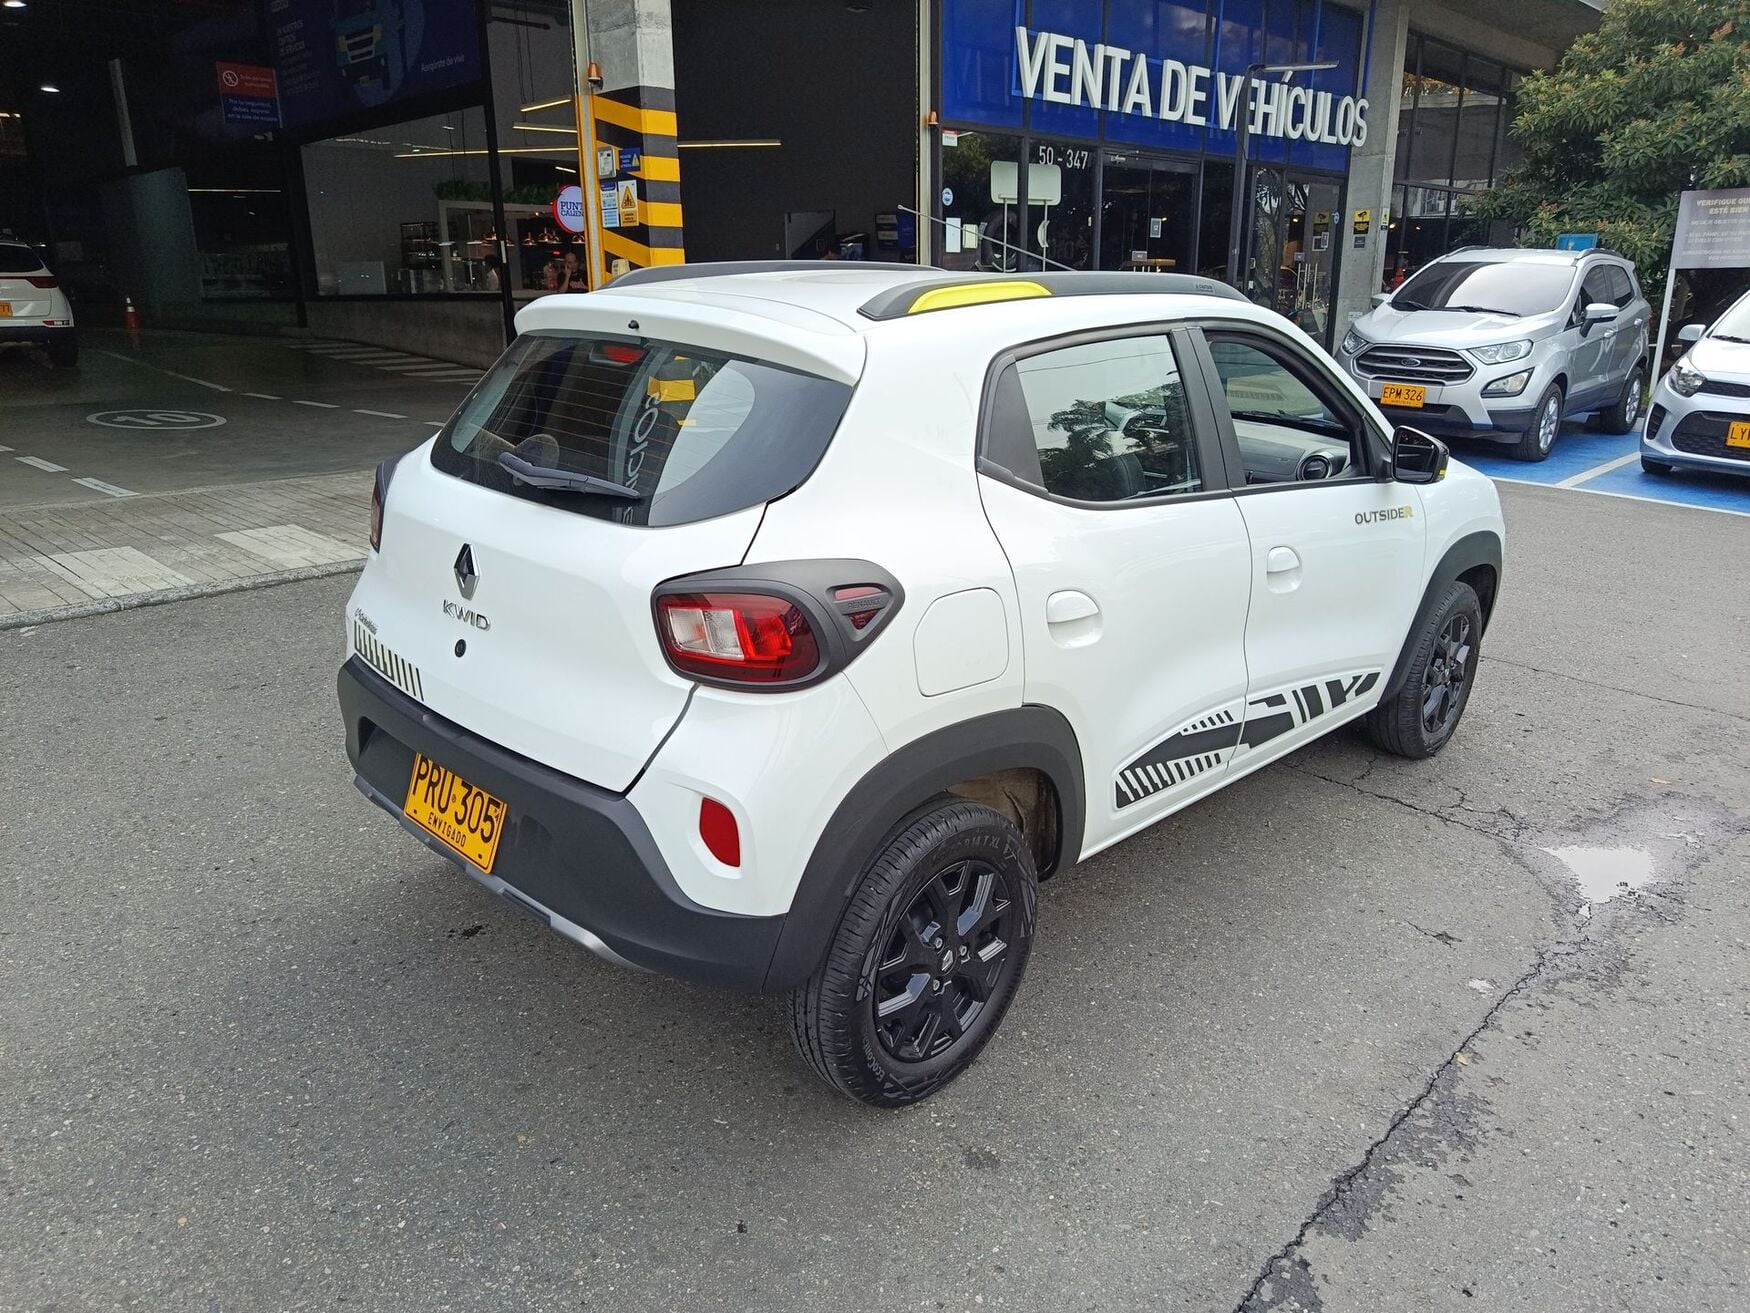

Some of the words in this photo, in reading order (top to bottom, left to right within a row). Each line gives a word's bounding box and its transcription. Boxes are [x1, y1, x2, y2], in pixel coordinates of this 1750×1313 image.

[1015, 26, 1152, 117] VENTA
[1160, 59, 1211, 125] DE
[1039, 145, 1054, 165] 50
[1066, 148, 1088, 170] 347
[560, 201, 583, 211] PUNT
[1383, 387, 1403, 399] EPM
[1404, 388, 1423, 402] 326
[1355, 506, 1415, 525] OUTSIDER
[443, 599, 491, 632] KWID
[412, 755, 456, 814] PRU
[454, 779, 501, 844] 305
[427, 811, 467, 848] ENVIGADO
